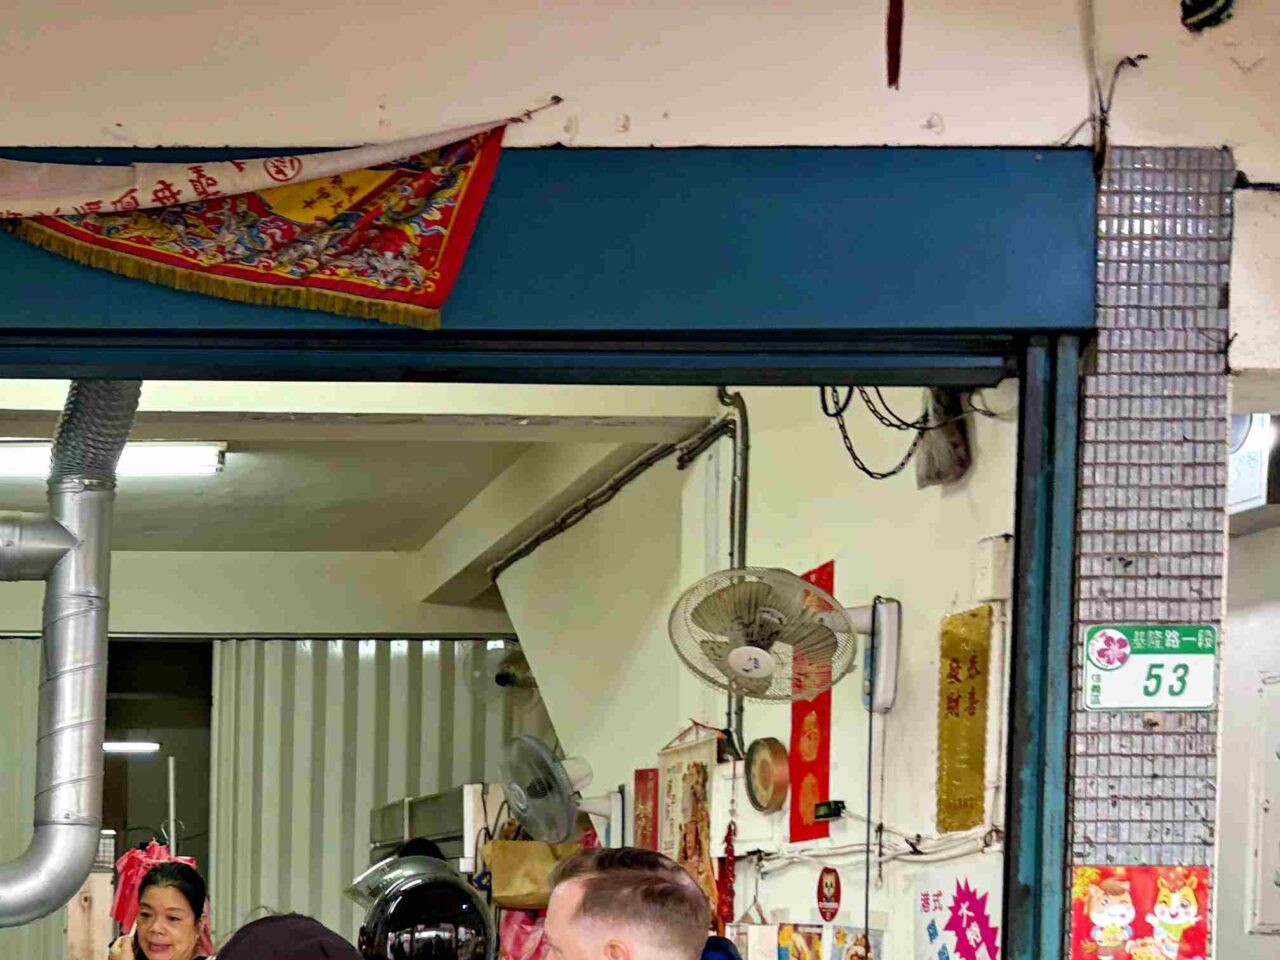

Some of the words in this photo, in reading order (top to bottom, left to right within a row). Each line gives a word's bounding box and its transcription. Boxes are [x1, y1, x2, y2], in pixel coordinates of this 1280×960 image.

[1132, 629, 1213, 649] 基隆路一段
[1143, 663, 1189, 697] 53
